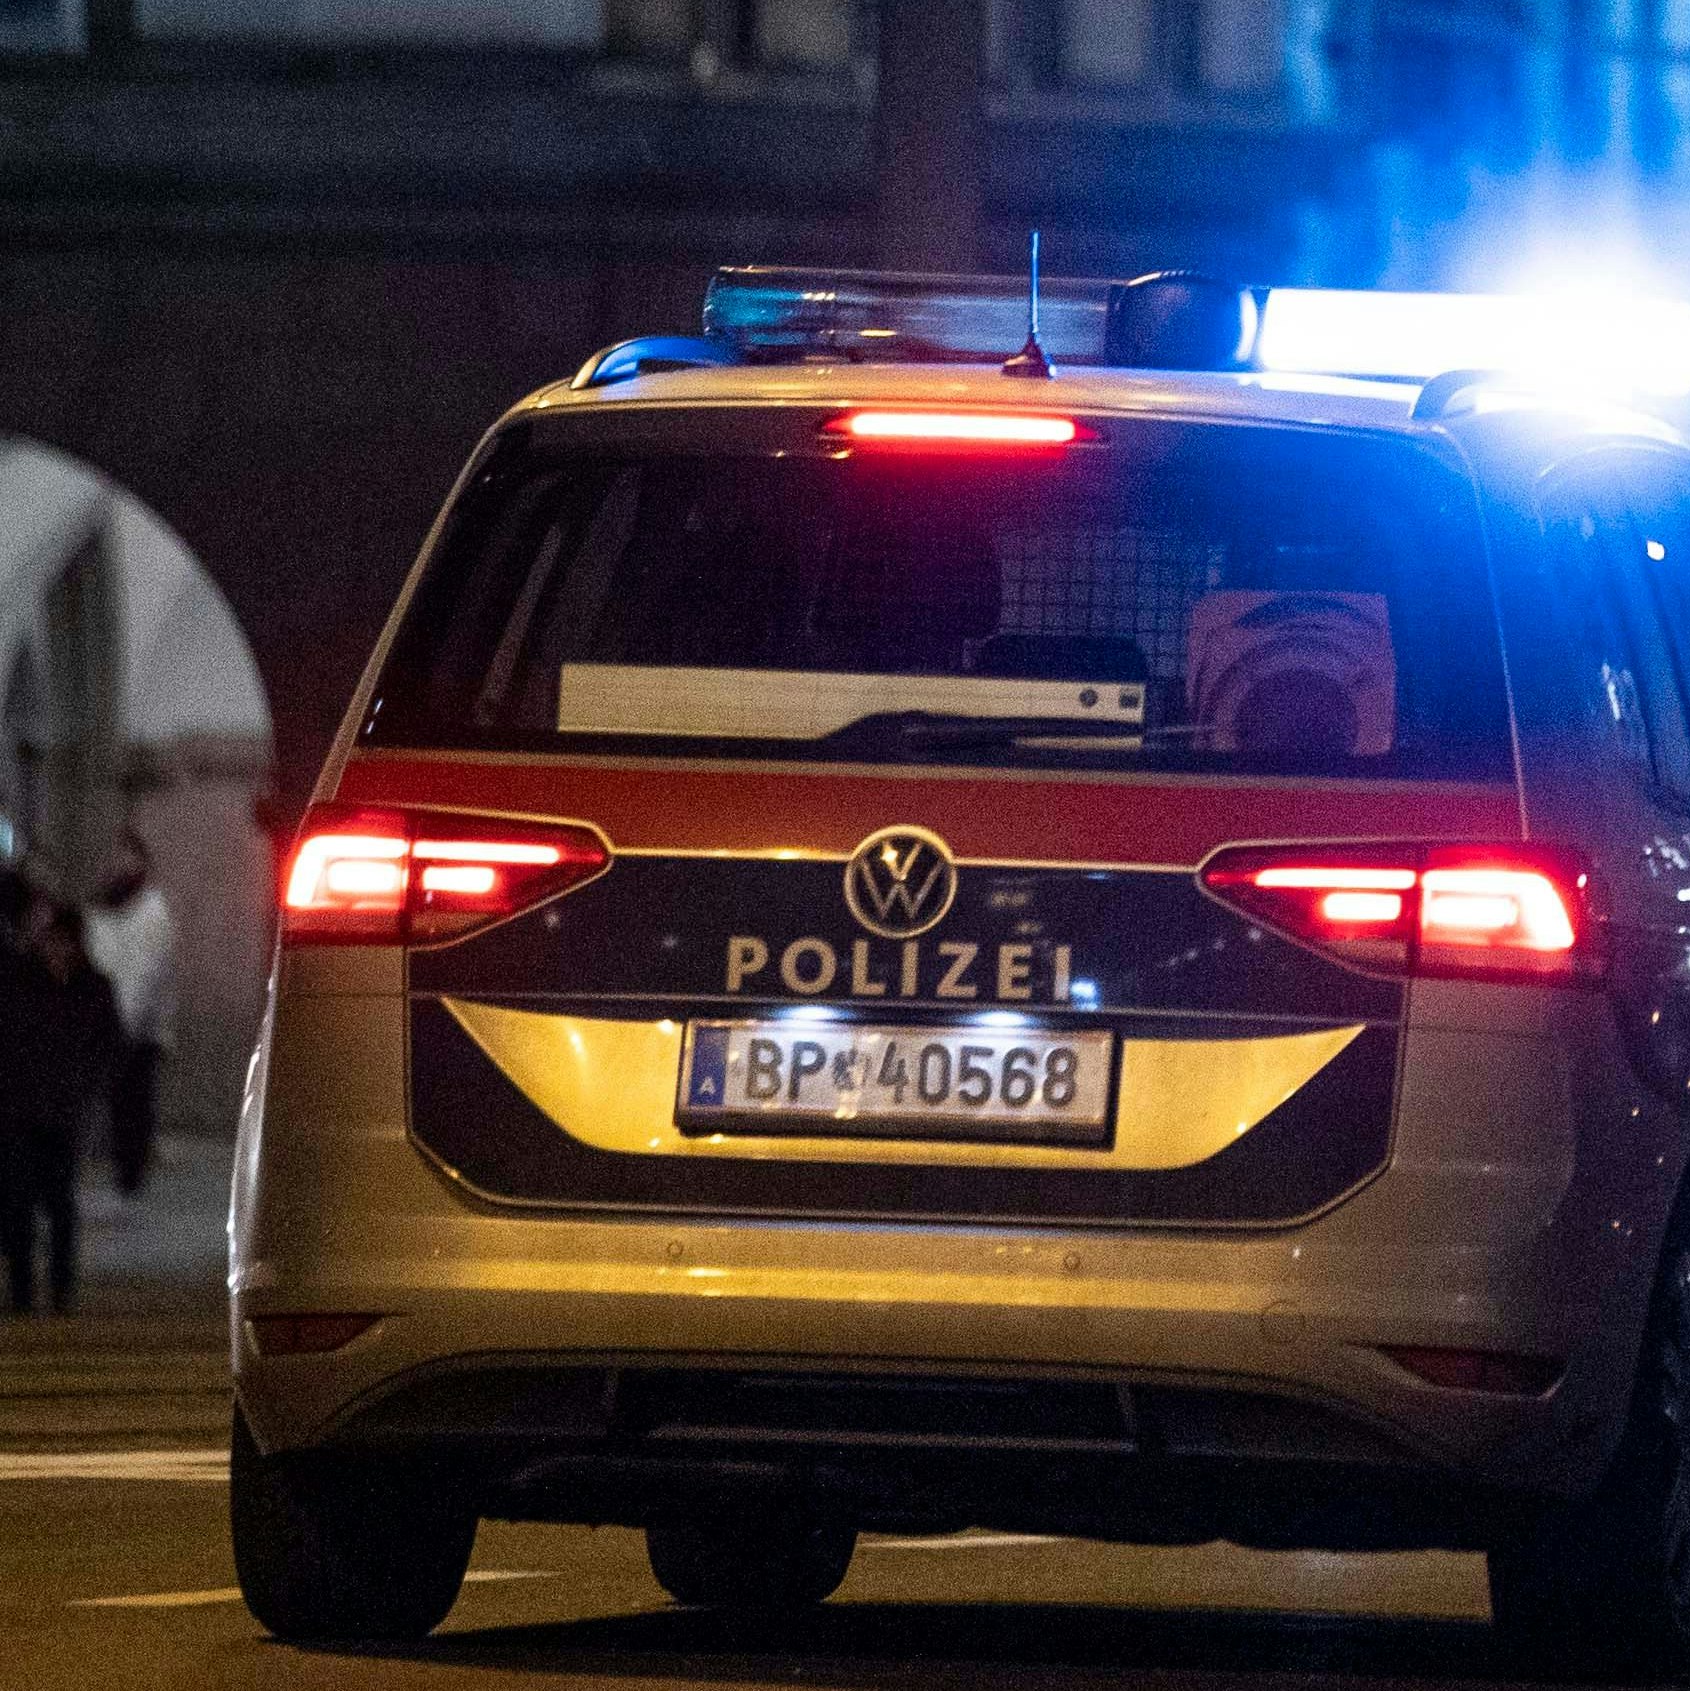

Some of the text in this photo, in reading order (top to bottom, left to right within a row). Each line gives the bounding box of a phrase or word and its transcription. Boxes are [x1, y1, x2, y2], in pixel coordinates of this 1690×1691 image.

[726, 936, 1071, 1001] POLIZEI
[700, 1077, 716, 1096] A
[746, 1038, 1078, 1108] BP 40568
